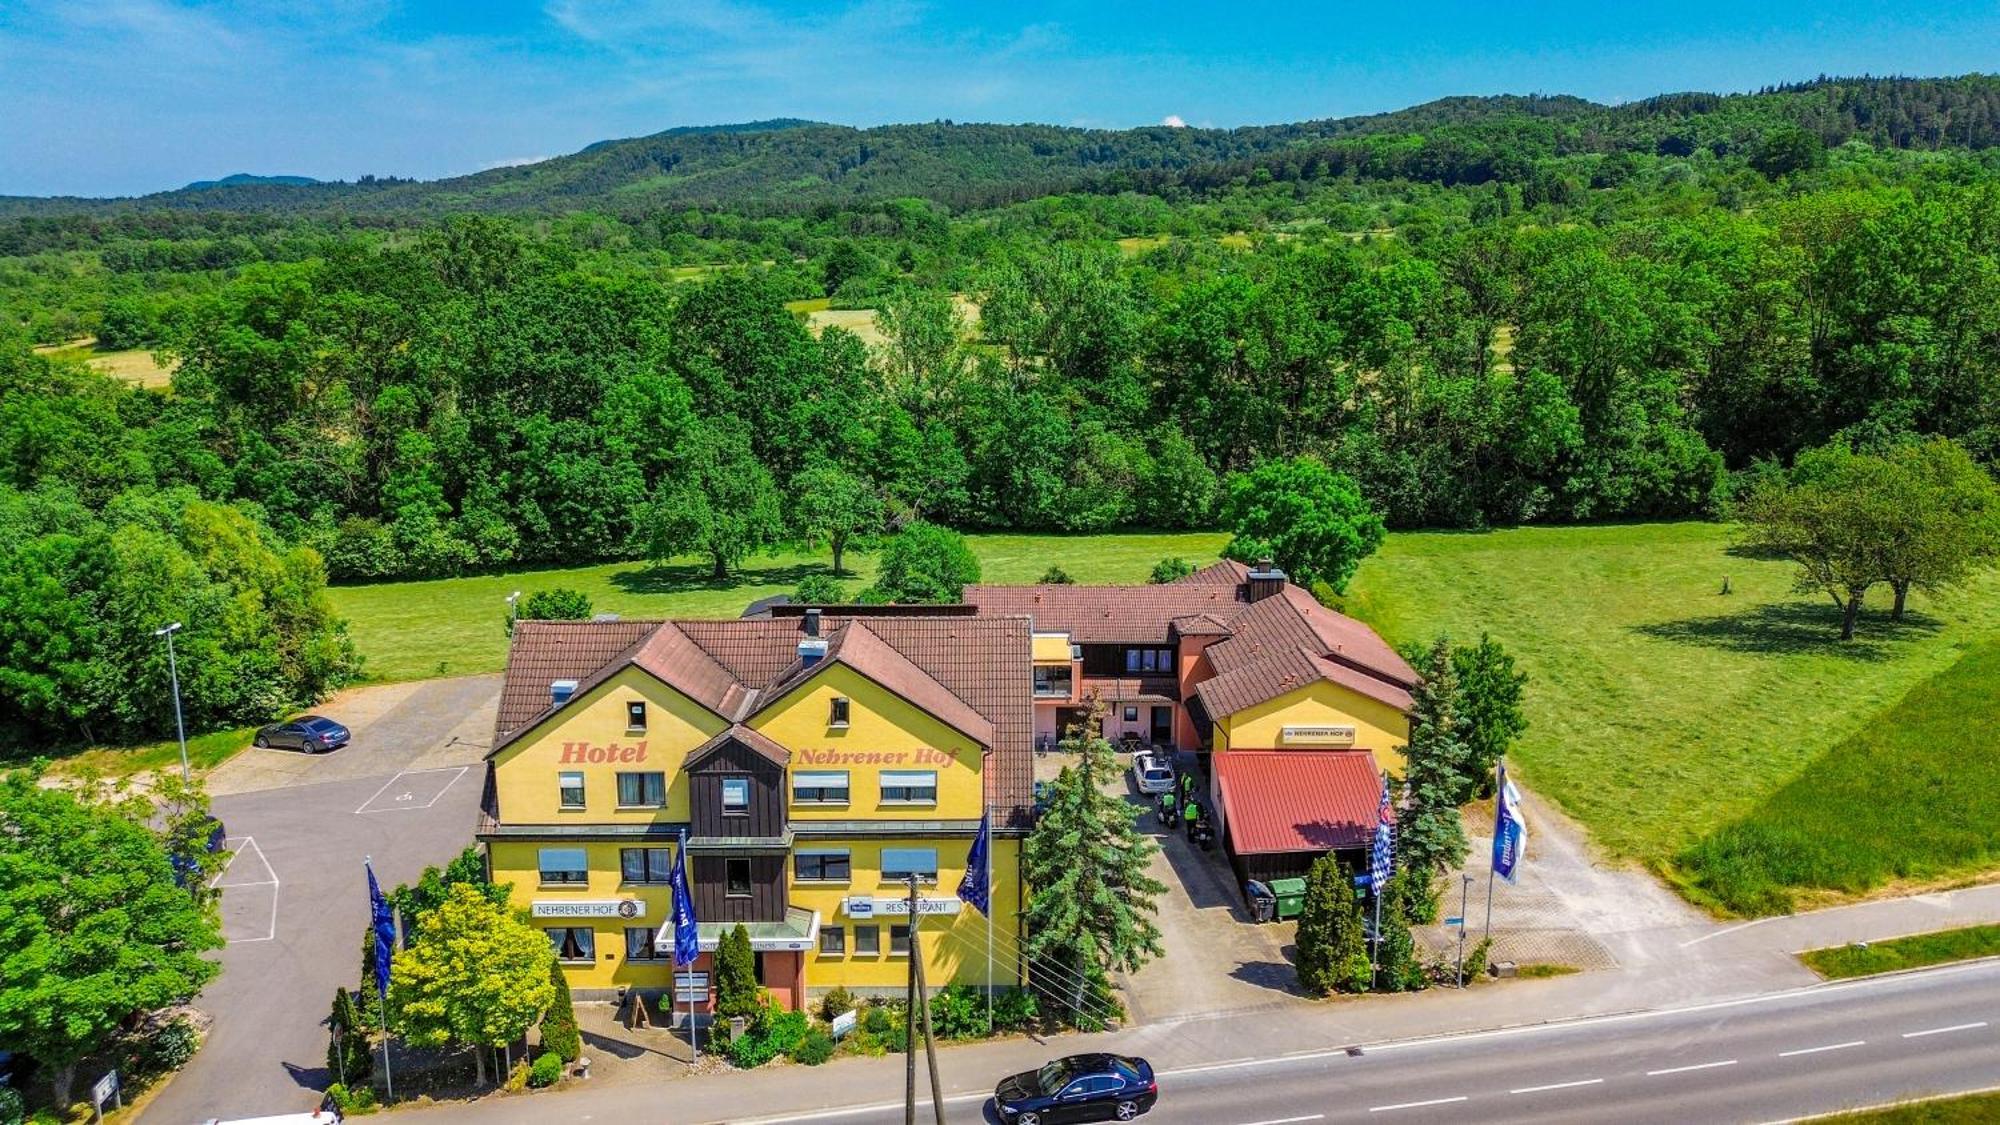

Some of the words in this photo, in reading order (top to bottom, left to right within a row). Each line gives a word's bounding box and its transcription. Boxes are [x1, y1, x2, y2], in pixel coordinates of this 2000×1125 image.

[558, 740, 649, 764] Hotel
[797, 748, 909, 765] Nehrener
[913, 746, 961, 769] Hof
[538, 906, 591, 915] NEHRENER
[592, 906, 614, 915] HOF
[885, 902, 947, 913] RESTURANT
